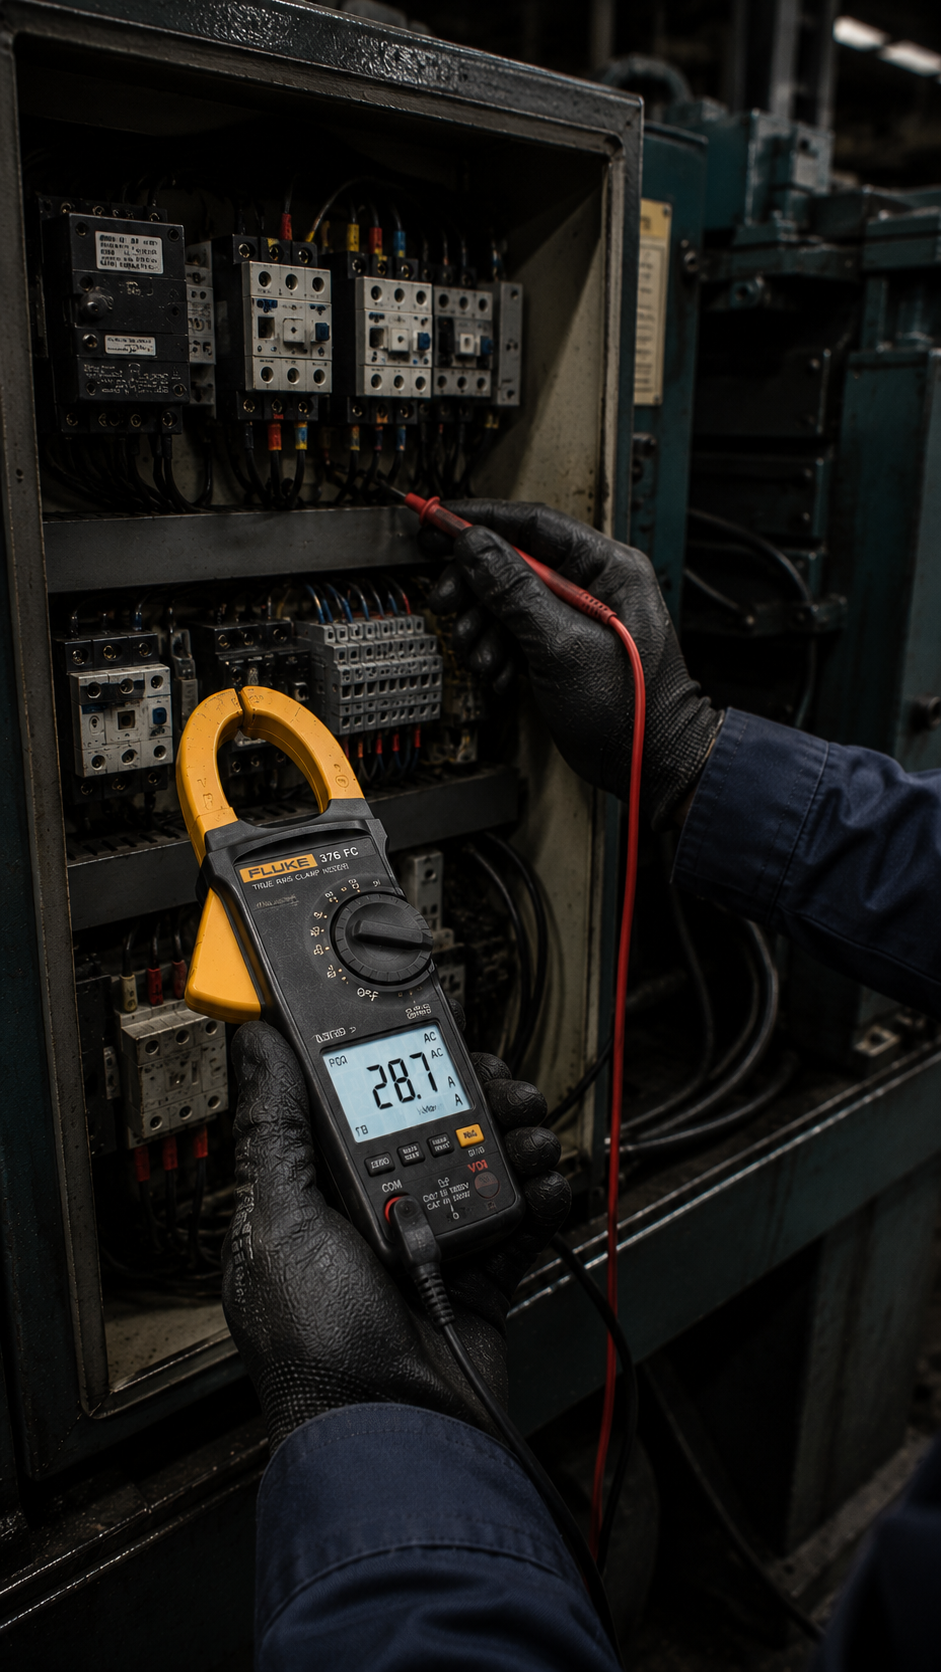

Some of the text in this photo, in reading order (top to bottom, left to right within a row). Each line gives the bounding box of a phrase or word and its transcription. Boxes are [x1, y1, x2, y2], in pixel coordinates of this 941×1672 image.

[248, 846, 359, 879] FLUKE 376 FC
[424, 1031, 437, 1043] AC
[431, 1047, 444, 1059] AC
[366, 1052, 438, 1110] 28.7
[447, 1076, 456, 1088] A
[454, 1093, 463, 1106] A
[382, 1179, 403, 1193] COM
